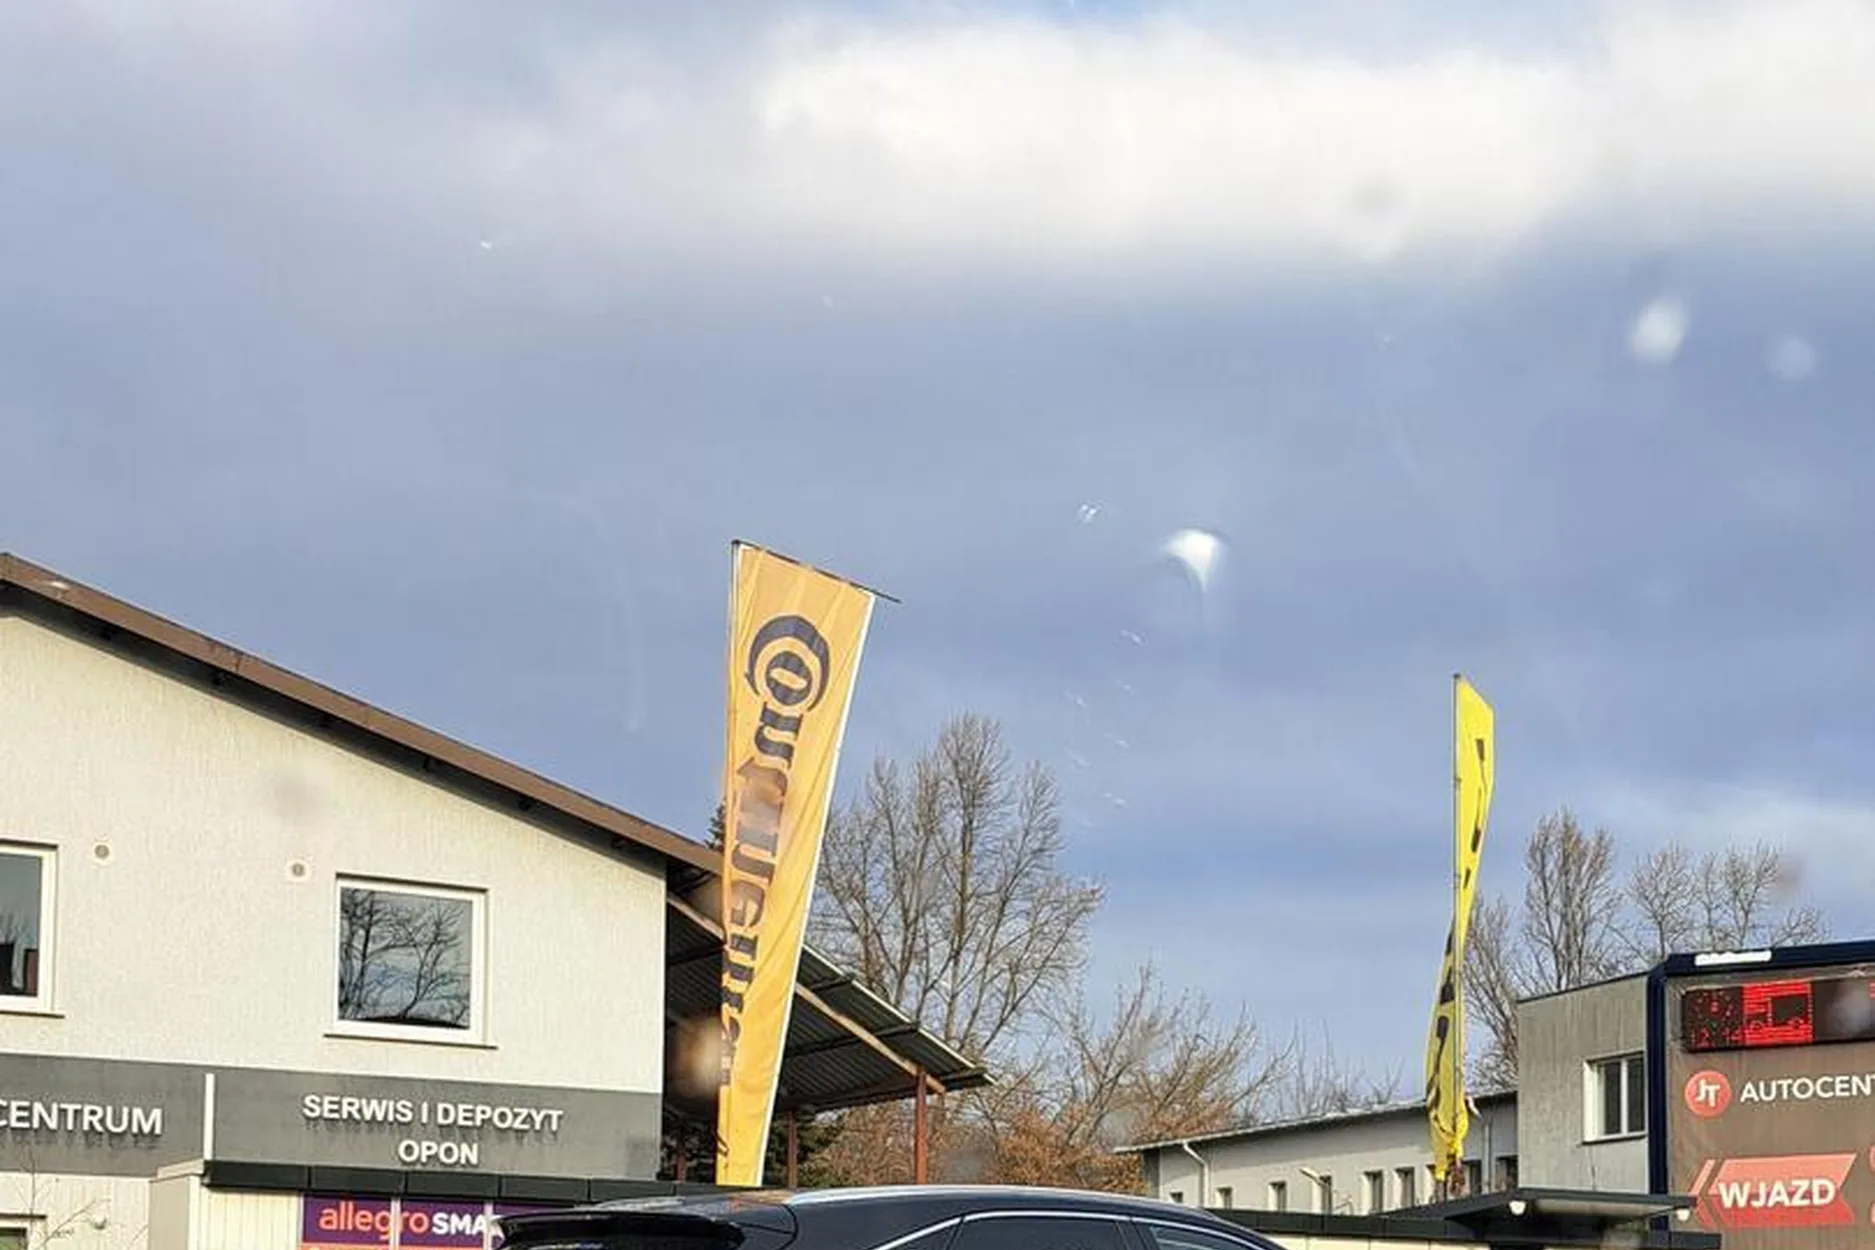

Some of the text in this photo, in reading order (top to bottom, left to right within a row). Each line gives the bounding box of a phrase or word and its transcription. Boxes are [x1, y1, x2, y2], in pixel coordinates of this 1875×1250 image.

[302, 1094, 564, 1132] SERWIS I DEPOZYT
[397, 1138, 480, 1166] OPON
[1718, 1178, 1837, 1209] WJAZD
[319, 1200, 429, 1240] allegro
